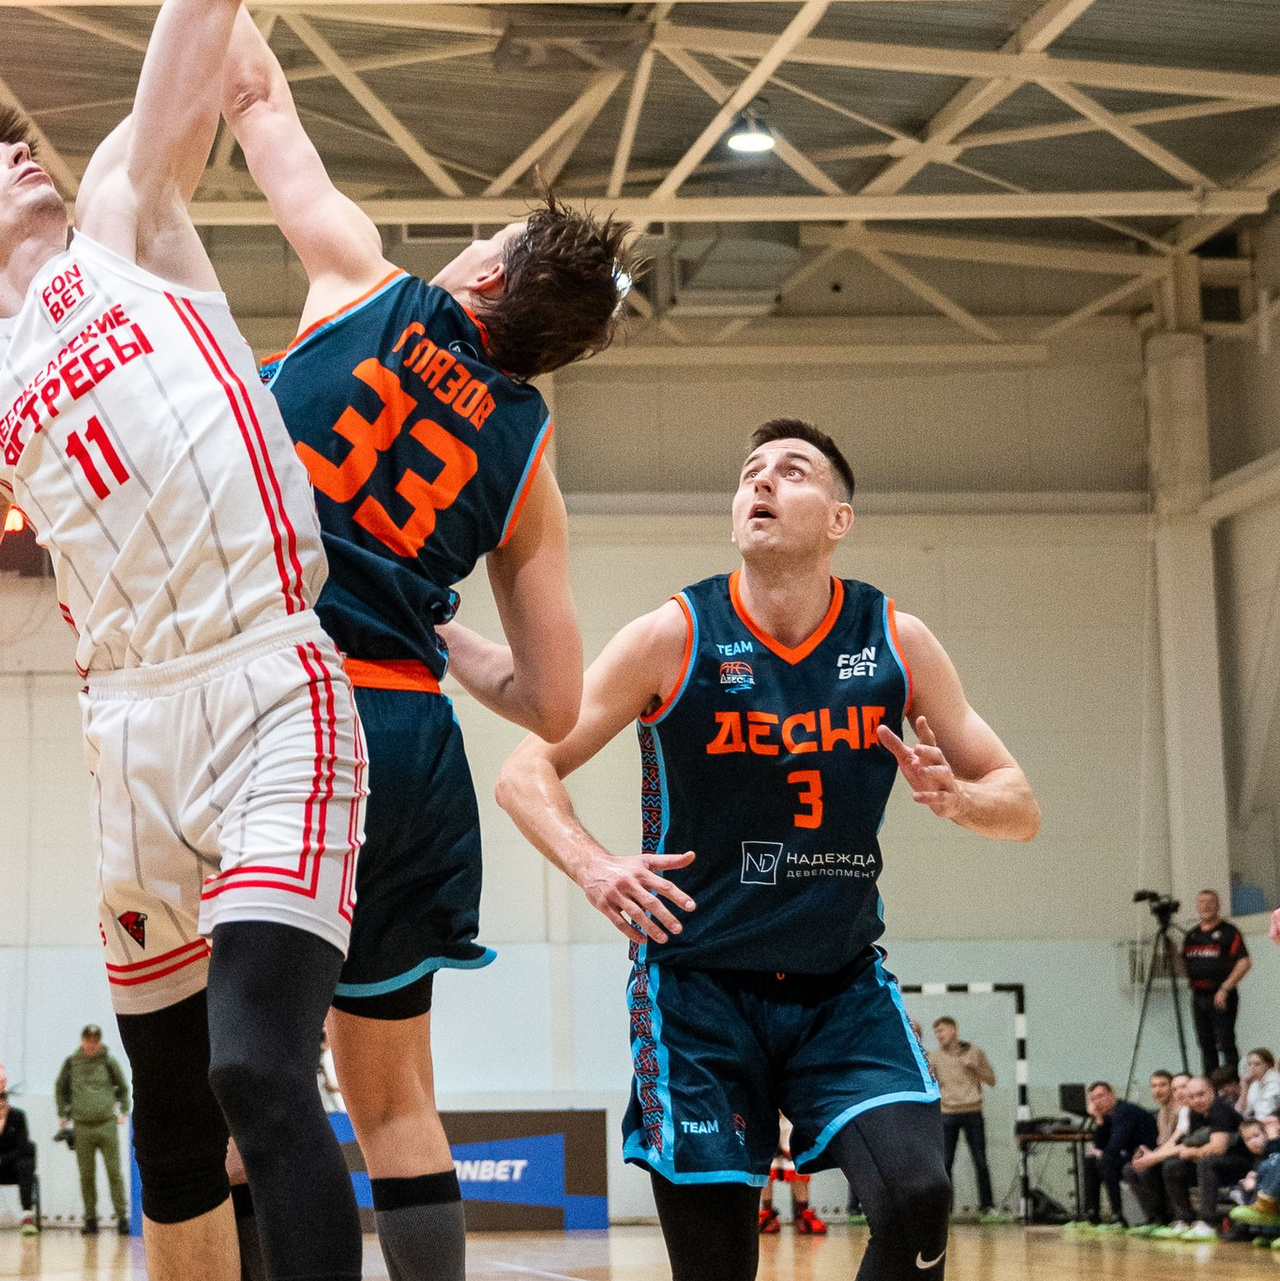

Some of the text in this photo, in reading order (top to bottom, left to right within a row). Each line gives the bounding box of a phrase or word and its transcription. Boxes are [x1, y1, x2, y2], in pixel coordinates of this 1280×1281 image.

[41, 263, 83, 308] FON
[49, 279, 86, 325] BET
[392, 320, 498, 431] ГЛАЗОВ
[64, 414, 131, 501] 11
[295, 356, 480, 560] 33
[715, 640, 754, 657] TEAM
[836, 646, 877, 668] FON
[838, 661, 878, 680] BET
[705, 705, 887, 757] ДЕСНА
[786, 769, 825, 830] 3
[786, 852, 877, 867] НАДЕЖДА
[786, 868, 876, 879] ДЕВЕЛОПМЕНТ
[680, 1120, 720, 1134] TEAM
